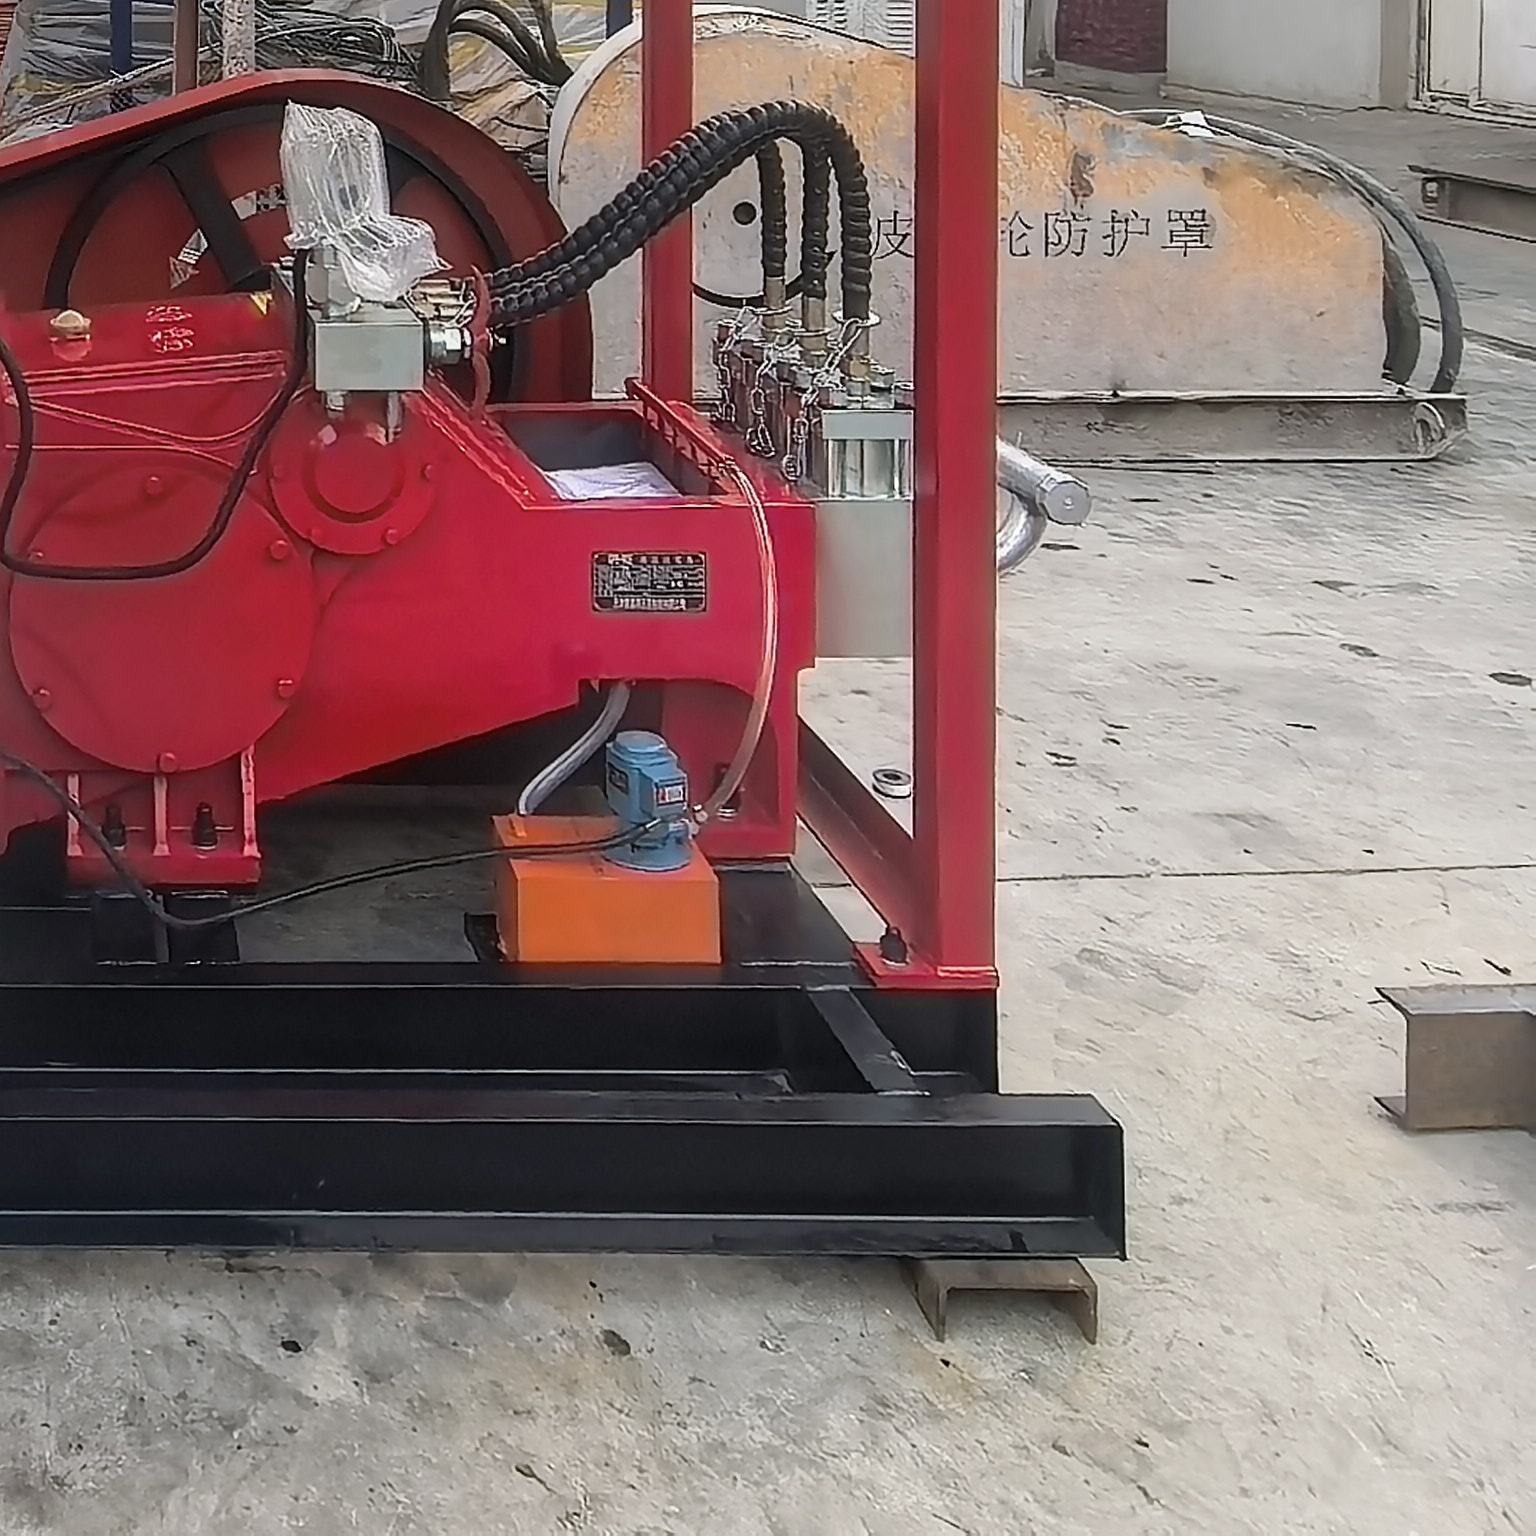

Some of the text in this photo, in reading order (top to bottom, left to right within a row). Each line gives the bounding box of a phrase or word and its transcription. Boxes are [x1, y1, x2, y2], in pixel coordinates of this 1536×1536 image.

[872, 209, 1213, 259] 皮轮防护罩
